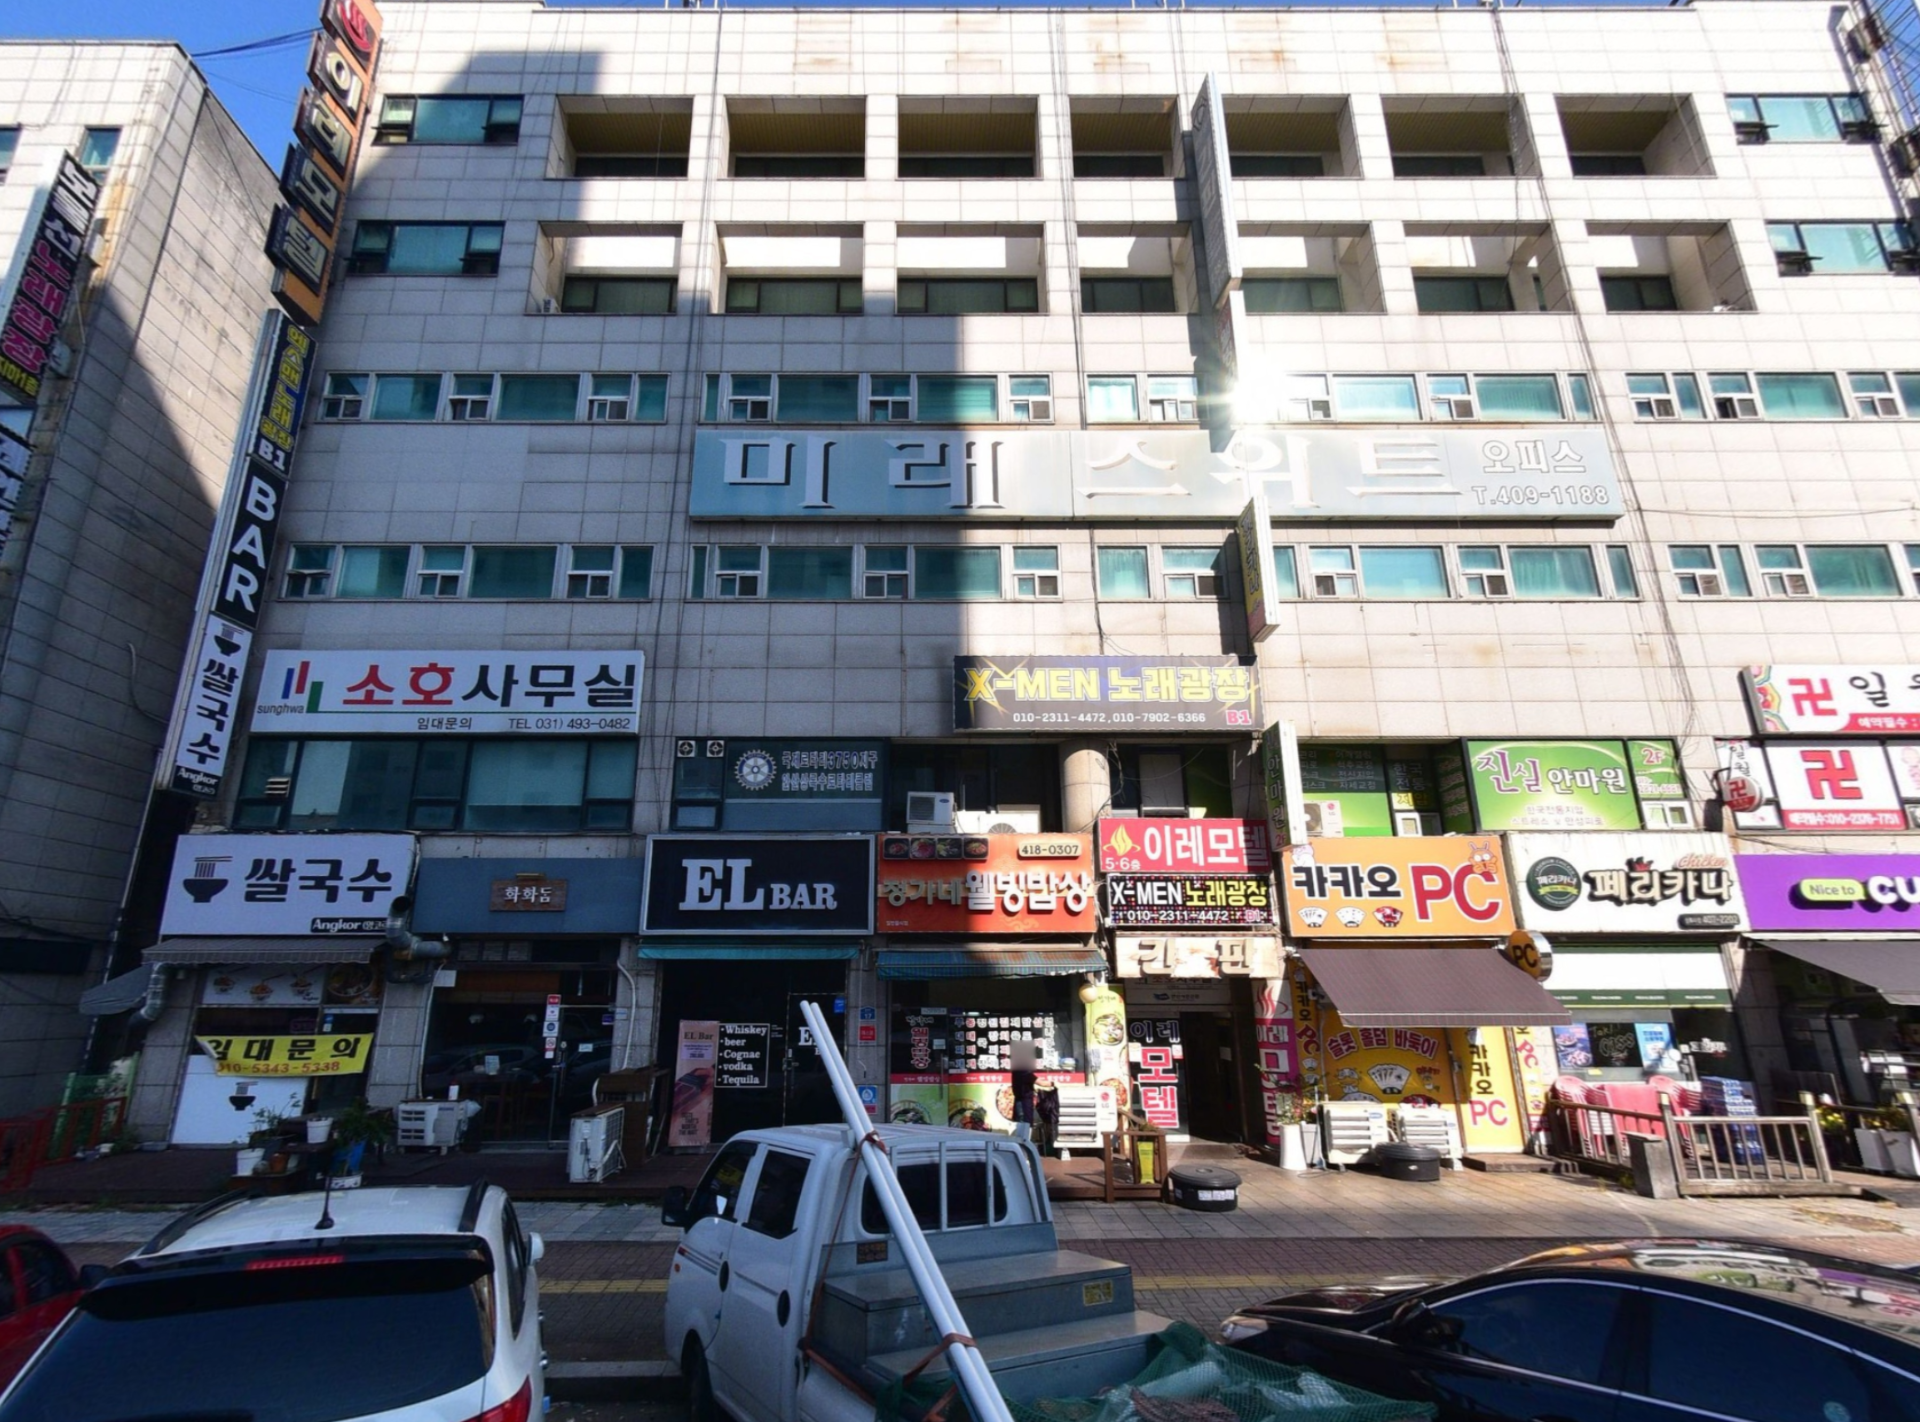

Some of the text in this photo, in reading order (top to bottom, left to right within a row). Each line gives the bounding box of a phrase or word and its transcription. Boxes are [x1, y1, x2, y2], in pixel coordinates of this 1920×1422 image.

[283, 51, 365, 288] 이레모텔
[1, 242, 72, 374] 노래광장
[279, 325, 309, 385] 엑스맨
[259, 439, 285, 470] B1
[1481, 439, 1588, 474] 오피스
[1471, 485, 1610, 505] T.409-1188
[232, 475, 277, 613] BAR
[342, 662, 636, 708] 소호사무실
[964, 666, 1250, 703] X-MEN 노래광장
[186, 658, 239, 764] 쌀국수
[417, 717, 473, 730] 임대문의
[1226, 709, 1252, 726] B1
[508, 718, 631, 731] TEL 031) 493-0482
[1641, 748, 1665, 765] 2F
[178, 767, 219, 786] Angkor
[1476, 750, 1544, 794] 진실
[1547, 767, 1628, 795] 안마원
[1021, 844, 1079, 855] 418-0307
[1143, 825, 1268, 867] 이레모텔
[244, 858, 394, 903] 쌀국수
[679, 859, 838, 911] EL BAR
[883, 869, 1092, 912] 정가네 웰빙밥상
[1292, 863, 1502, 921] 카카오 PC
[1588, 869, 1734, 902] 페리카나
[1809, 885, 1839, 895] Nice
[1842, 885, 1855, 895] to
[503, 886, 553, 903] 화화돔
[1112, 881, 1268, 906] X-MEN 노래광장
[313, 918, 361, 933] Angkor
[1127, 910, 1229, 921] 010-2311-4472
[1513, 943, 1538, 968] PC
[684, 1032, 714, 1040] EL Bar
[724, 1037, 746, 1046] beer
[725, 1025, 767, 1036] Whiskey
[1130, 1020, 1180, 1044] 이레
[1256, 1024, 1289, 1044] 이레
[1296, 1024, 1320, 1055] PC
[205, 1038, 361, 1061] 임대문의
[723, 1050, 761, 1060] Cognac
[1394, 1028, 1438, 1060] 바둑이
[1517, 1039, 1538, 1069] PC
[216, 1061, 340, 1074] 010-5343-5338
[723, 1062, 753, 1071] vodka
[1469, 1044, 1494, 1095] 카카오
[722, 1075, 760, 1085] Tequila
[1138, 1046, 1179, 1128] 모텔
[1469, 1099, 1508, 1127] PC
